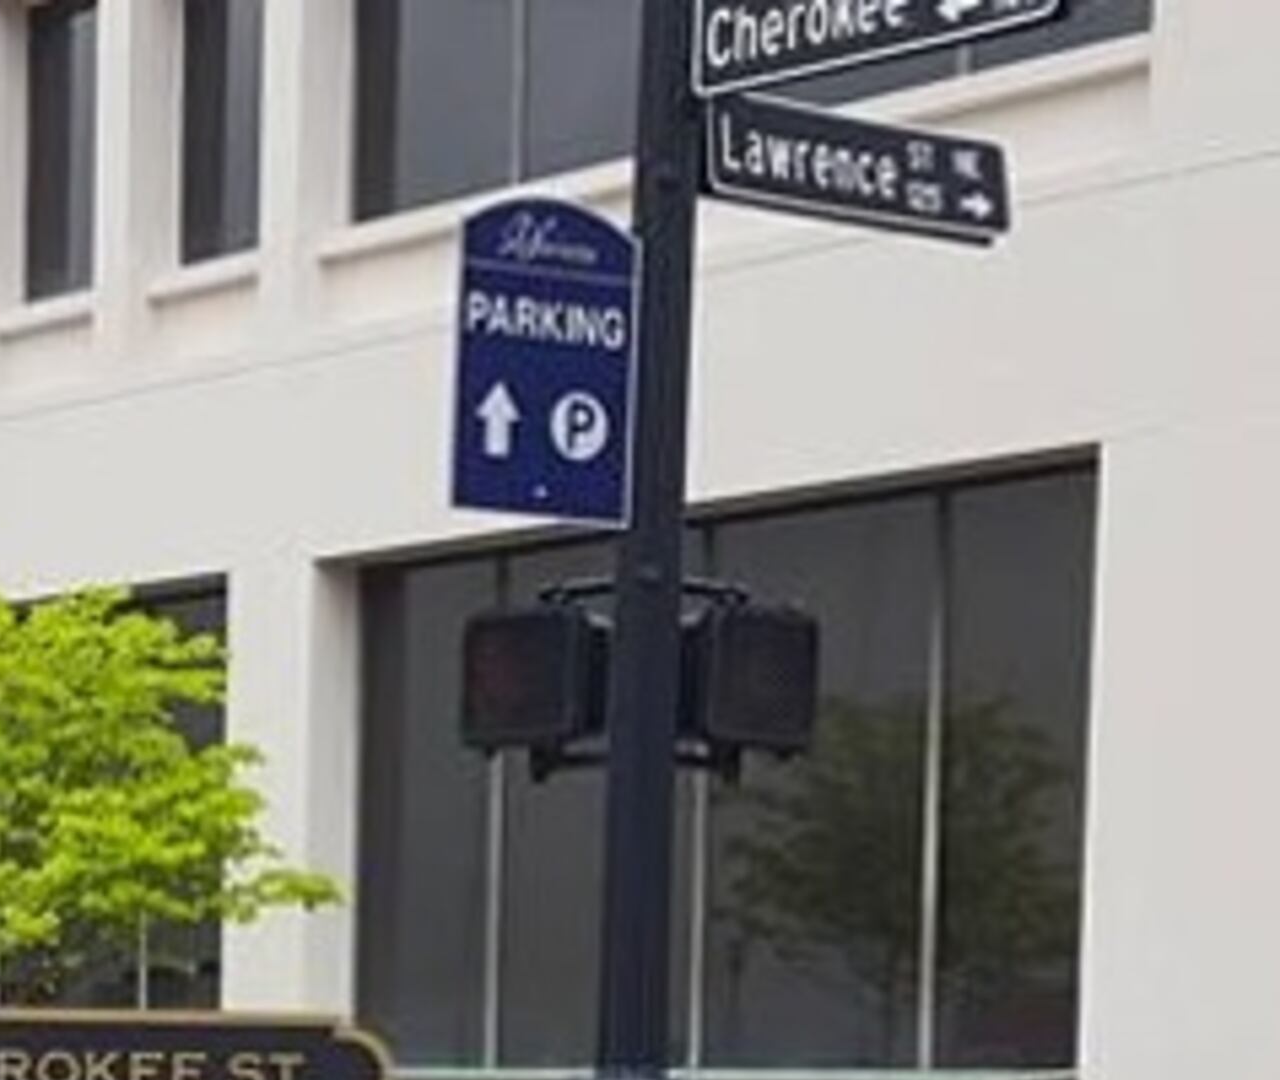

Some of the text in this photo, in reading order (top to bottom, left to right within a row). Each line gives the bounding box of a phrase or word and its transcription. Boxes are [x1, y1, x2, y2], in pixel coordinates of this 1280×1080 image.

[706, 0, 907, 67] Cherokee
[720, 113, 899, 199] Lawrence
[466, 290, 625, 350] PARKING
